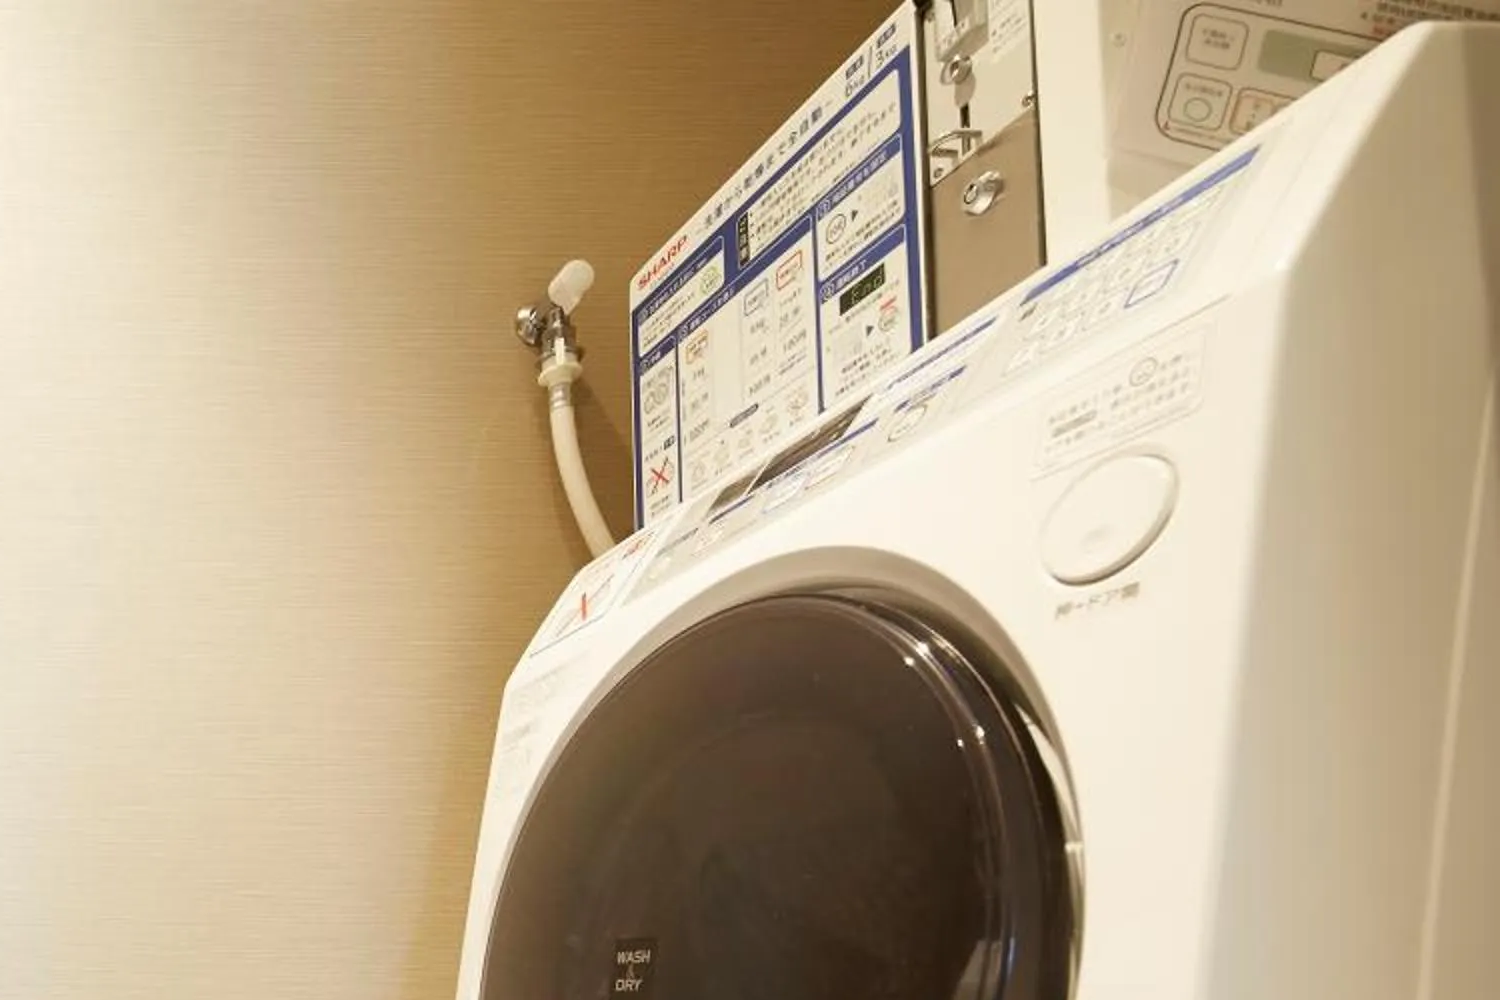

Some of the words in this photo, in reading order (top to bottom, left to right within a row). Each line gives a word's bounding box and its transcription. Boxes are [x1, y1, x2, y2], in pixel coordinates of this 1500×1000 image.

[636, 235, 690, 290] SHARP
[617, 949, 651, 965] WASH
[615, 977, 643, 992] DRY
